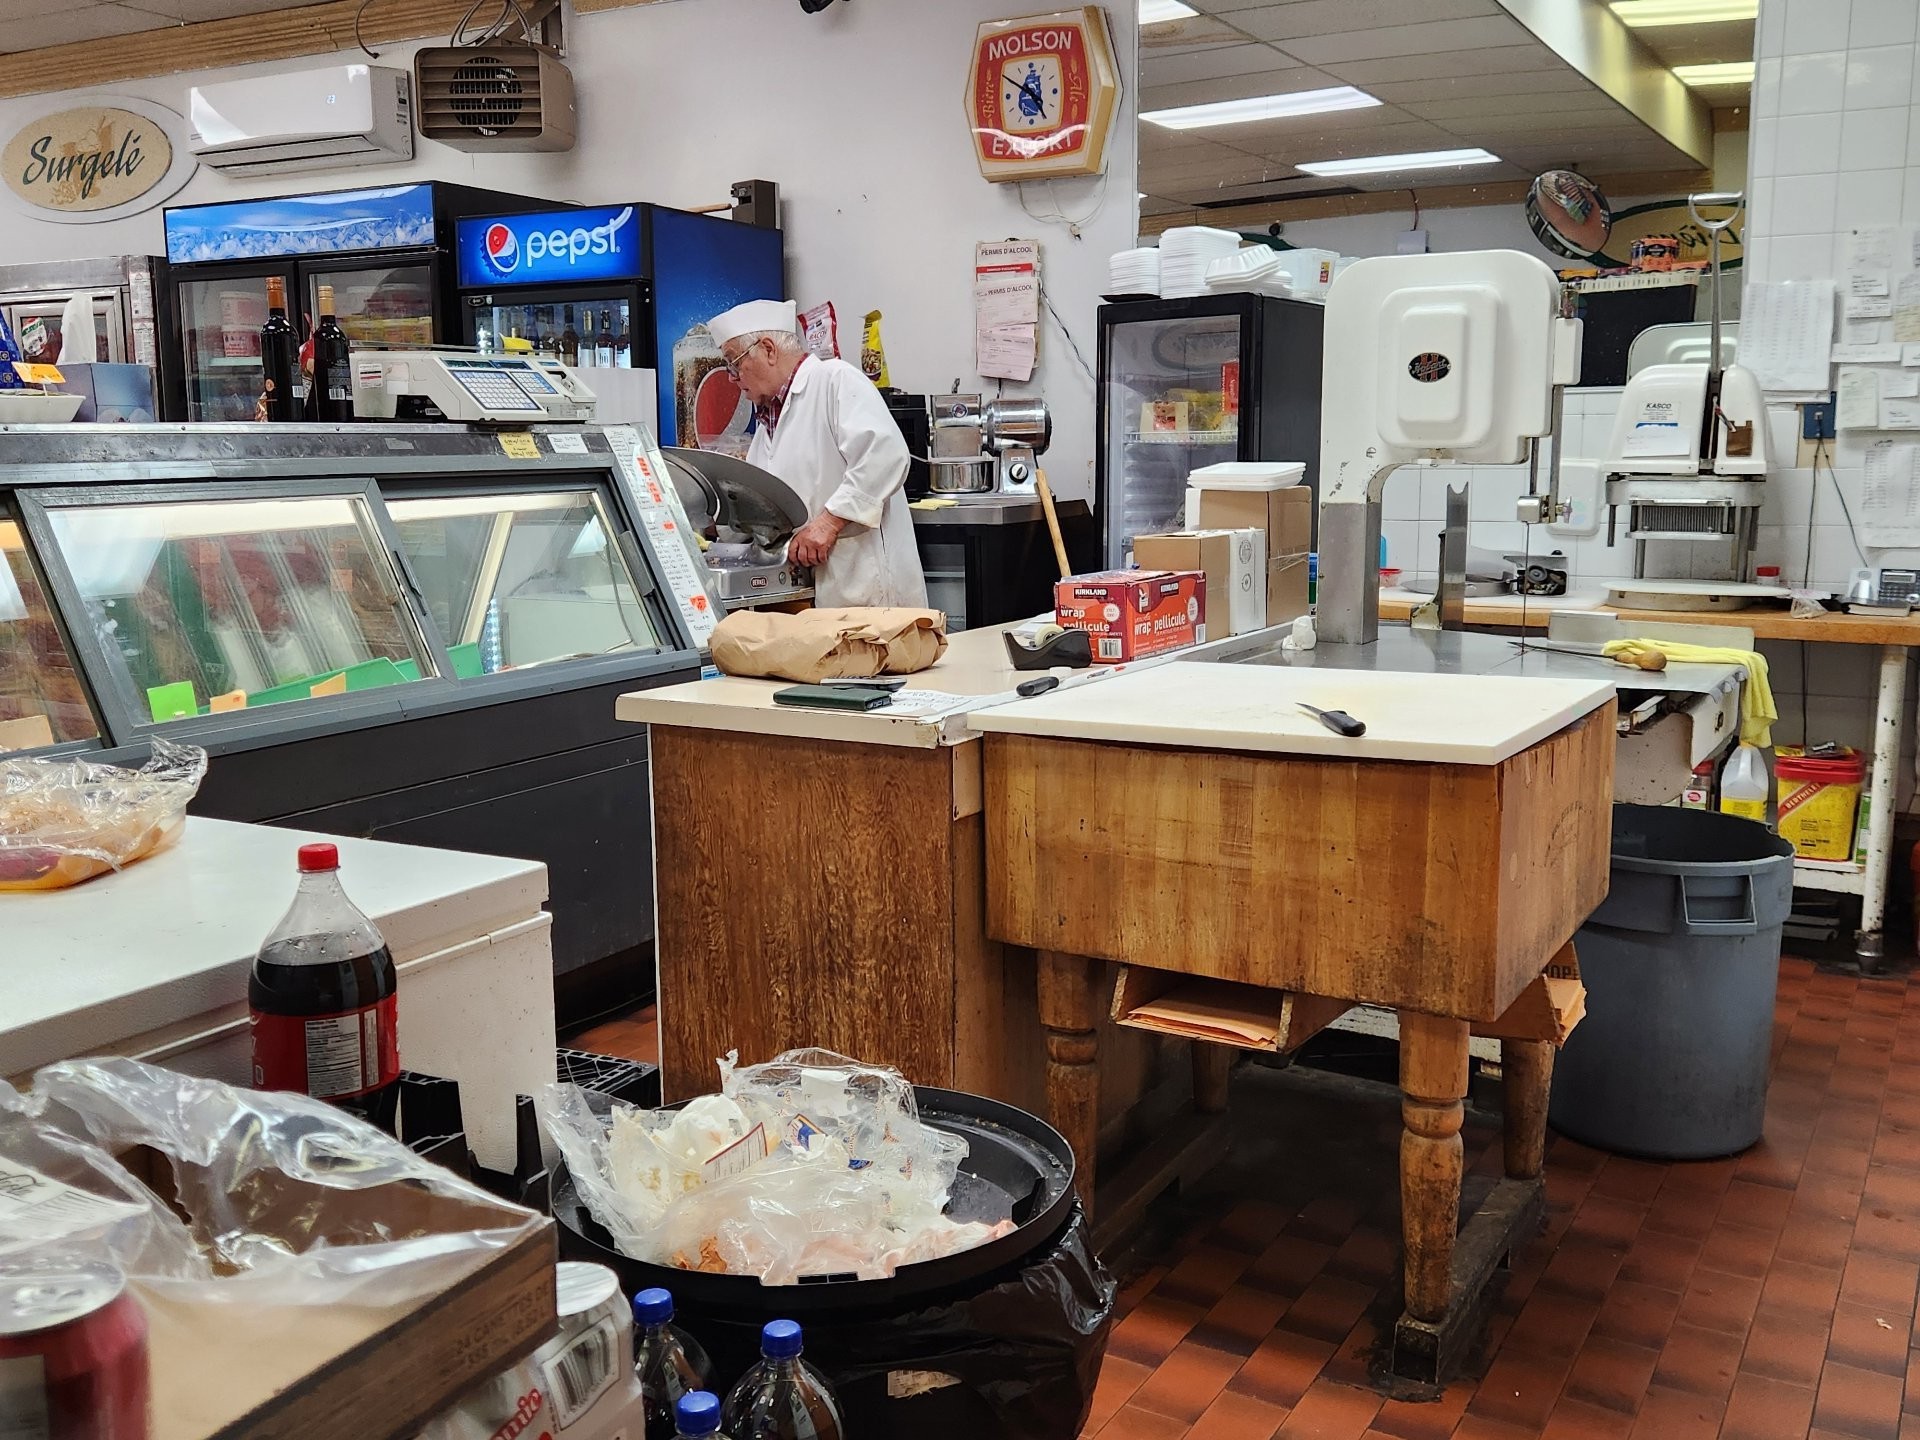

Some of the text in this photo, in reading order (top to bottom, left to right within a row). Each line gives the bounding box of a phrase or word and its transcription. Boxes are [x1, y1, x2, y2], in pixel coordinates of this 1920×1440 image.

[988, 30, 1072, 62] MOLSON
[981, 82, 995, 118] Bière
[992, 131, 1072, 156] EXORT
[22, 128, 146, 200] Surgelé
[526, 206, 633, 268] pepsi
[1003, 246, 1033, 255] D'ALCOOL
[987, 284, 1033, 296] PERMIS D'ALCOOL
[1646, 402, 1672, 410] KASCO
[1074, 588, 1107, 596] KIRKLAND
[1160, 582, 1179, 592] KIRKLAND
[1060, 608, 1085, 620] wrap
[1134, 611, 1186, 636] wrap pellicule
